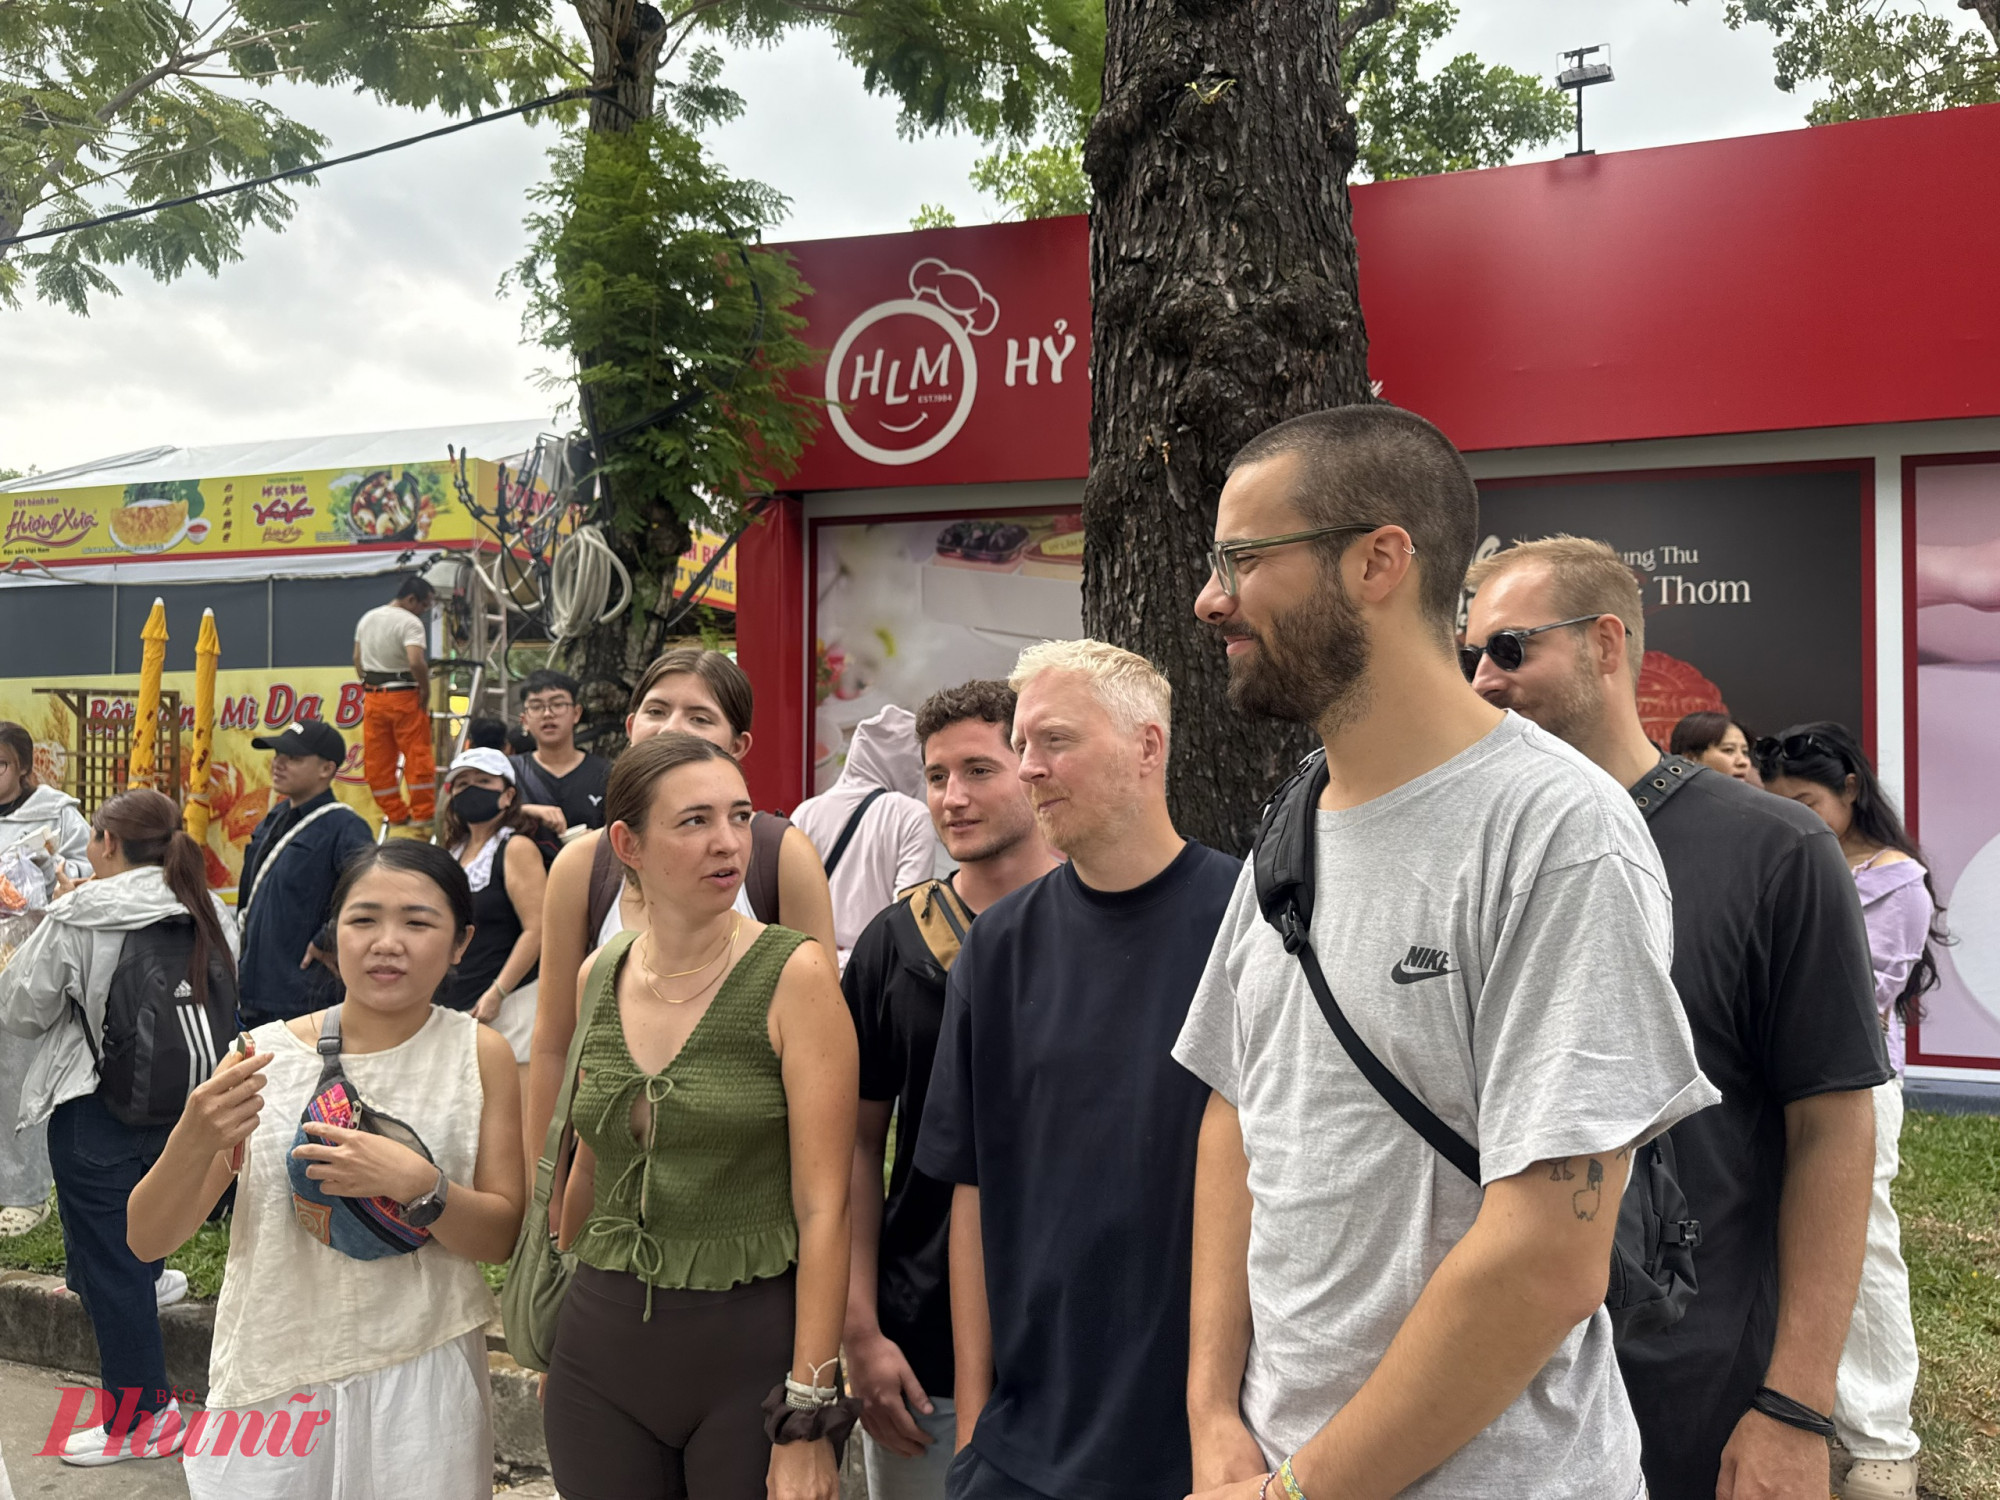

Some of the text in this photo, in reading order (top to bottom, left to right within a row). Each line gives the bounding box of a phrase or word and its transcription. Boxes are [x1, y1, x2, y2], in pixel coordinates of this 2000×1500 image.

[1005, 318, 1076, 387] HỶ
[850, 343, 951, 405] HLM
[1659, 546, 1700, 564] Thu
[1653, 575, 1751, 605] Thơm
[219, 695, 259, 729] Mì
[264, 683, 323, 728] Da
[1403, 945, 1450, 974] NIKE
